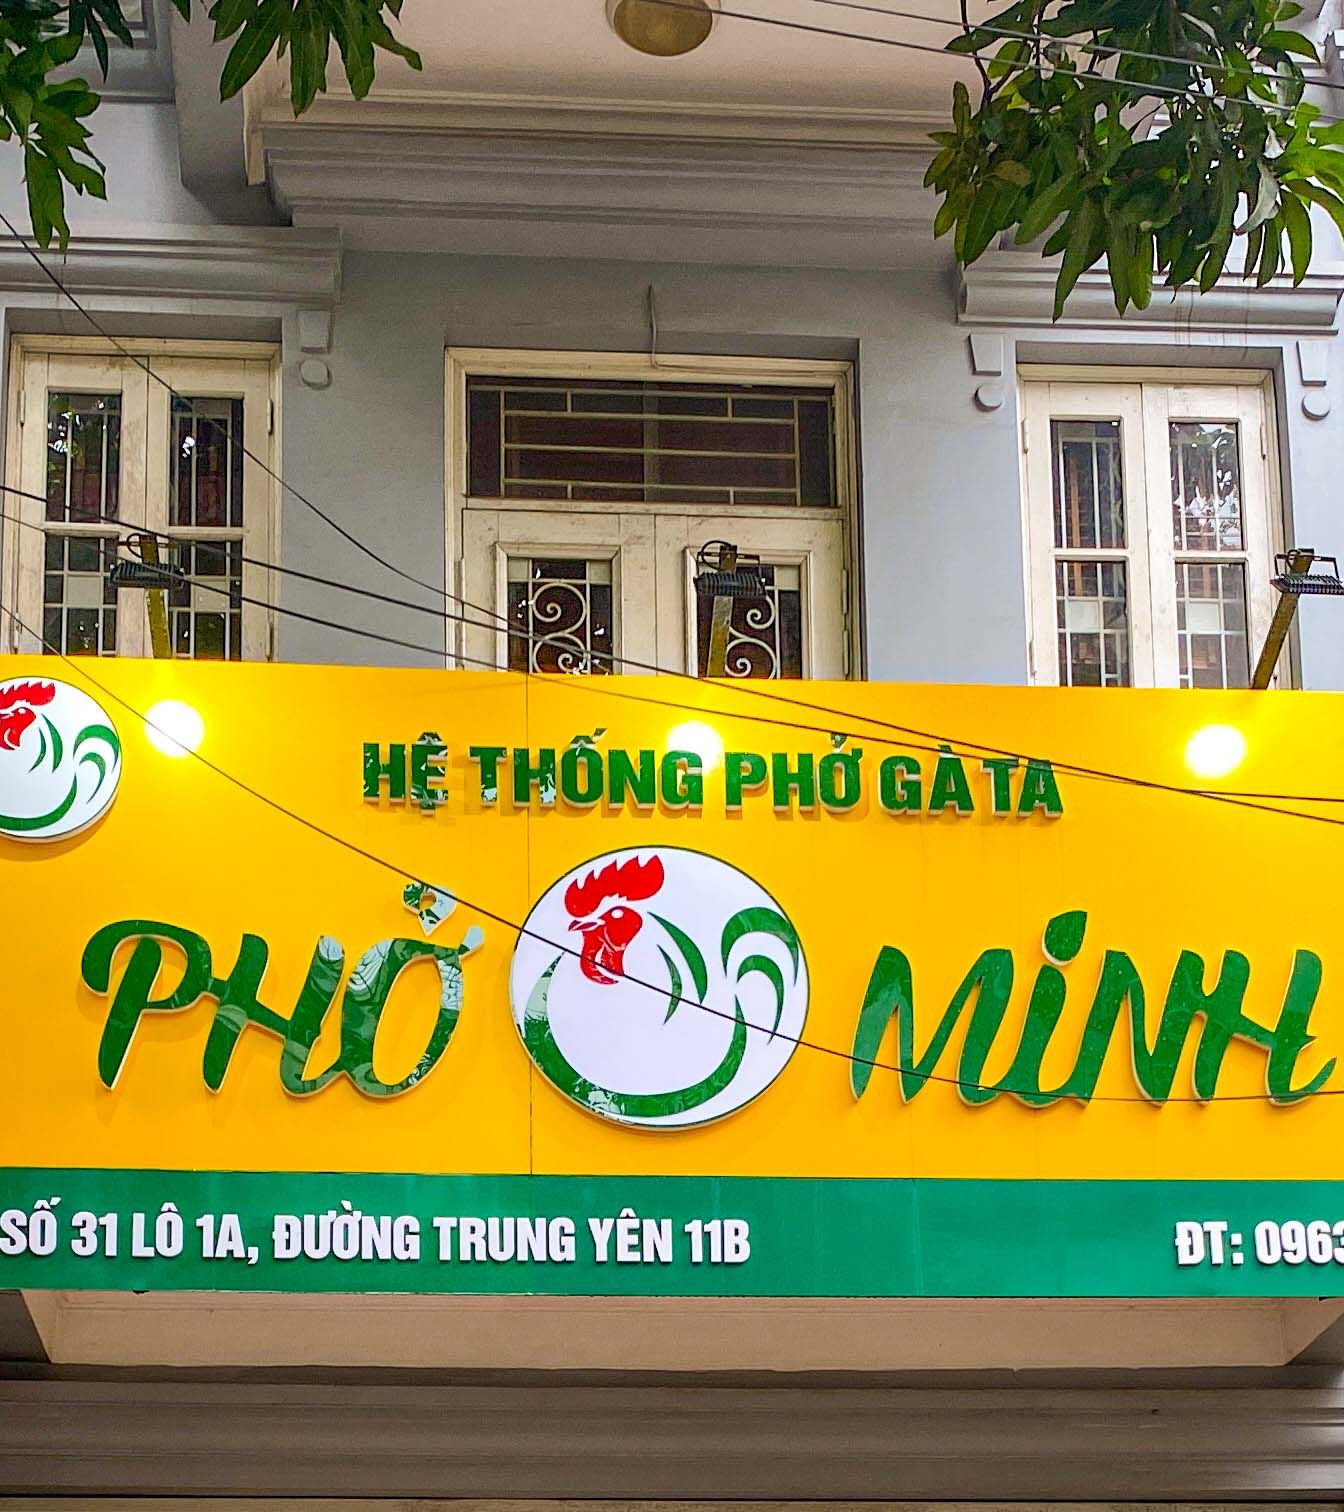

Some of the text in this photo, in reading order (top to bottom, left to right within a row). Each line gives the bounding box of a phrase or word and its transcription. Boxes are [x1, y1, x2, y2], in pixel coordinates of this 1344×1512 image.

[362, 729, 1064, 818] HỆ THỐNG PHỞ GÀ TA
[81, 880, 485, 1098] PHỞ
[71, 1213, 118, 1260] 31
[132, 1203, 185, 1260] LÔ
[195, 1214, 259, 1266] 1A,
[272, 1200, 421, 1262] ĐƯỜNG
[433, 1217, 576, 1263] TRUNG
[589, 1207, 675, 1264] YÊN
[684, 1218, 751, 1265] 11B
[1175, 1221, 1244, 1267] ĐT:
